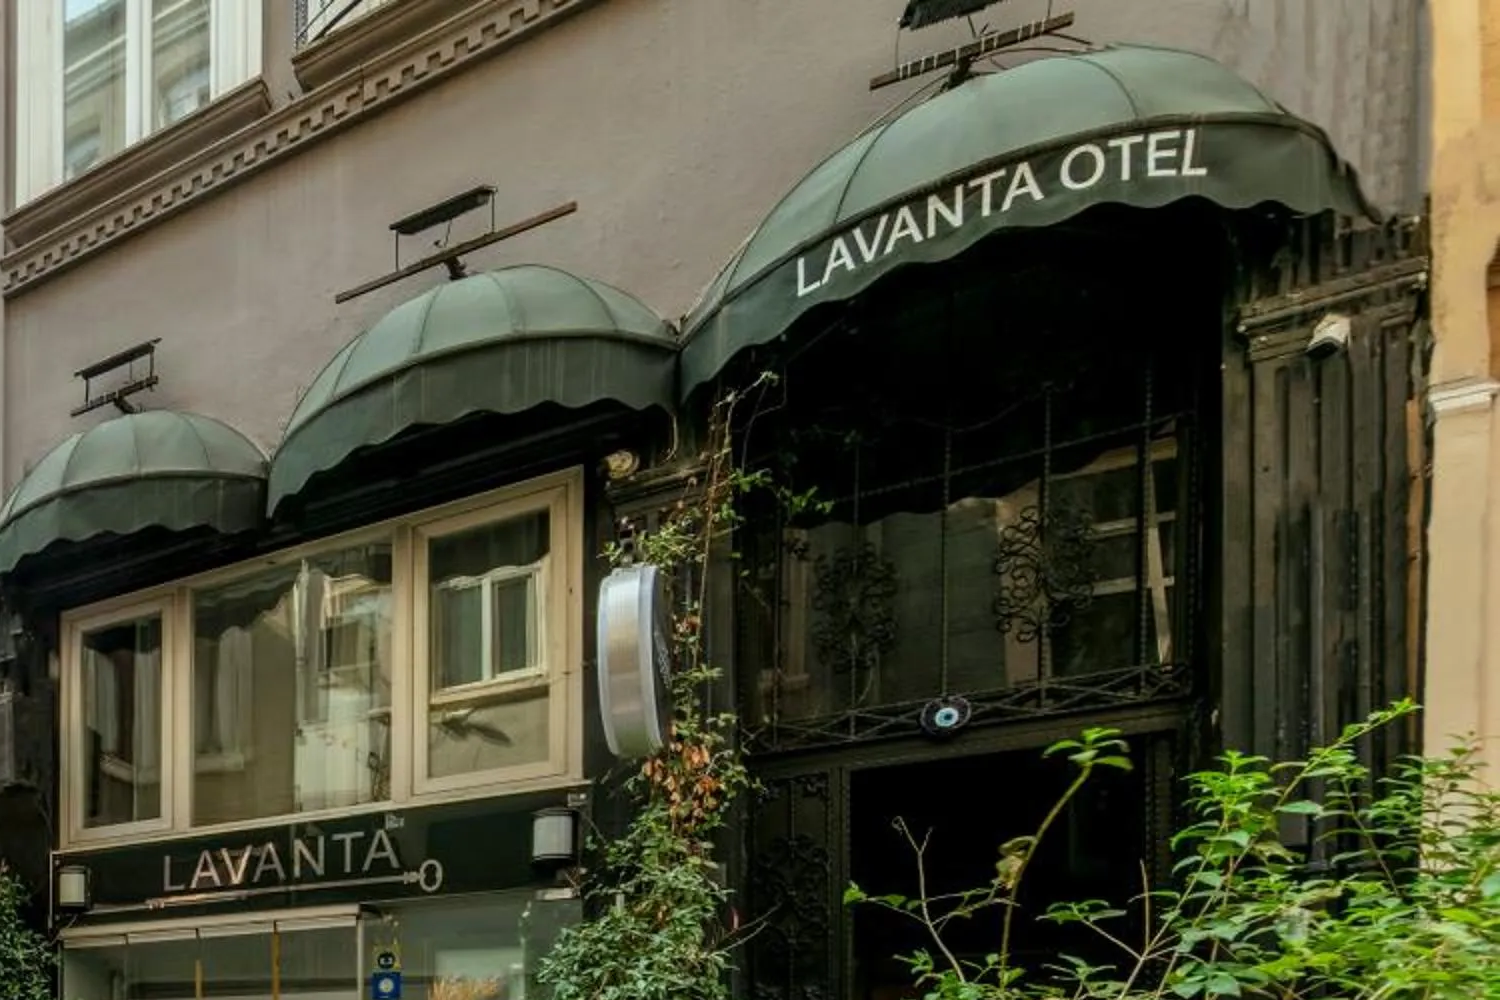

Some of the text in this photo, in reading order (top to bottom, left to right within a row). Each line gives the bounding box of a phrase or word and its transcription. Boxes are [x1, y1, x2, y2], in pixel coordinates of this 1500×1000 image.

[796, 128, 1208, 297] LAVANTA OTEL
[163, 828, 400, 892] LAVANTA
